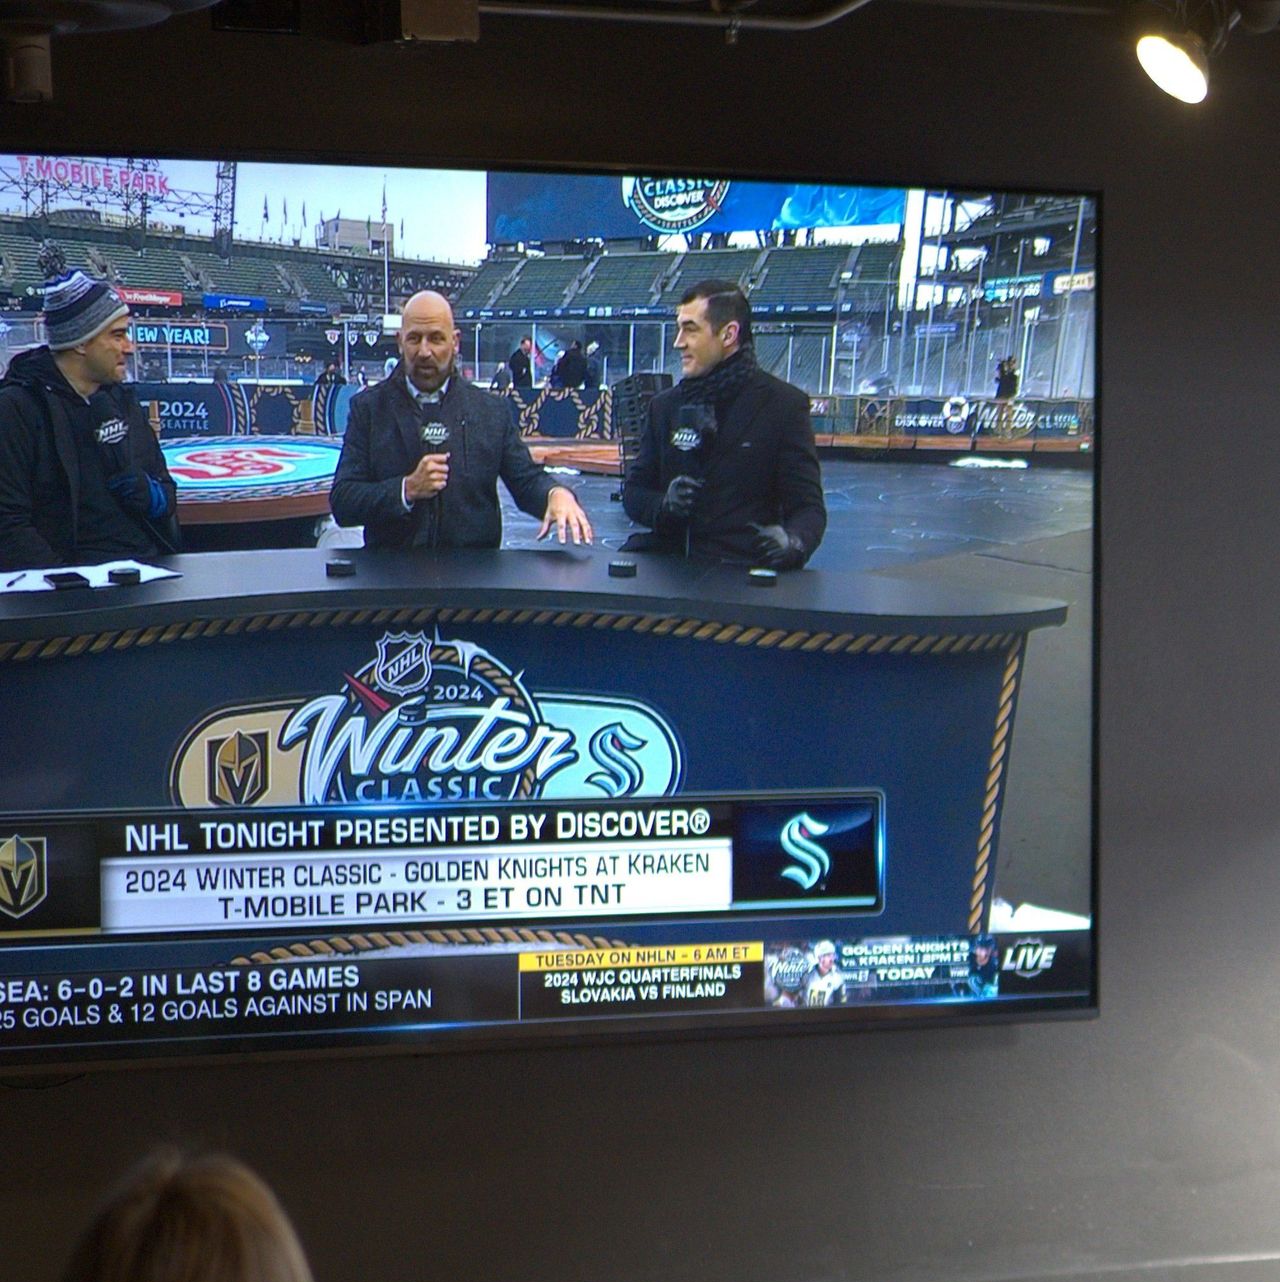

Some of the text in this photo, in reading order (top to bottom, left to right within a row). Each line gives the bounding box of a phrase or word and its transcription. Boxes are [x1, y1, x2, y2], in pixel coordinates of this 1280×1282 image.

[162, 327, 210, 344] YEAR!
[160, 401, 208, 417] 2024
[160, 419, 209, 430] SEATTLE
[388, 648, 421, 681] NHL
[433, 684, 484, 701] 2024
[281, 694, 577, 804] Winter
[355, 776, 502, 801] CLASSIC
[125, 823, 189, 852] NHL
[200, 820, 325, 849] TONIGHT
[335, 814, 500, 846] PRESENTED
[510, 813, 547, 841] BY
[126, 868, 187, 893] 2024
[196, 866, 285, 890] WINTER
[293, 863, 382, 888] CLASSIC
[404, 860, 489, 883] GOLDEN
[498, 857, 587, 880] KNIGHTS
[595, 855, 619, 877] AT
[628, 852, 710, 876] KRAKEN
[218, 894, 345, 920] T-MOBILE
[356, 890, 427, 914] PARK
[456, 889, 472, 910] 3
[484, 887, 514, 909] ET
[525, 886, 562, 907] ON
[574, 883, 626, 905] TNT
[536, 953, 604, 968] TUESDAY
[609, 951, 631, 965] ON
[636, 949, 676, 964] NHLN
[693, 950, 701, 961] 6
[706, 948, 727, 960] AM
[732, 947, 749, 959] ET
[842, 941, 970, 956] GOLDEN KNIGHTS
[1003, 946, 1057, 972] LIVE
[57, 976, 134, 1001] 6-0-2
[142, 974, 168, 997] IN
[176, 971, 240, 995] LAST
[247, 970, 262, 992] 8
[269, 966, 360, 991] GAMES
[544, 964, 742, 988] 2024 WJC QUARTERFINALS
[876, 967, 936, 981] TODAY
[561, 982, 726, 1004] SLOVAKIA VS FINLAND
[0, 988, 432, 1030] 5 GOALS & 12 GOALS AGAINST IN SPAN
